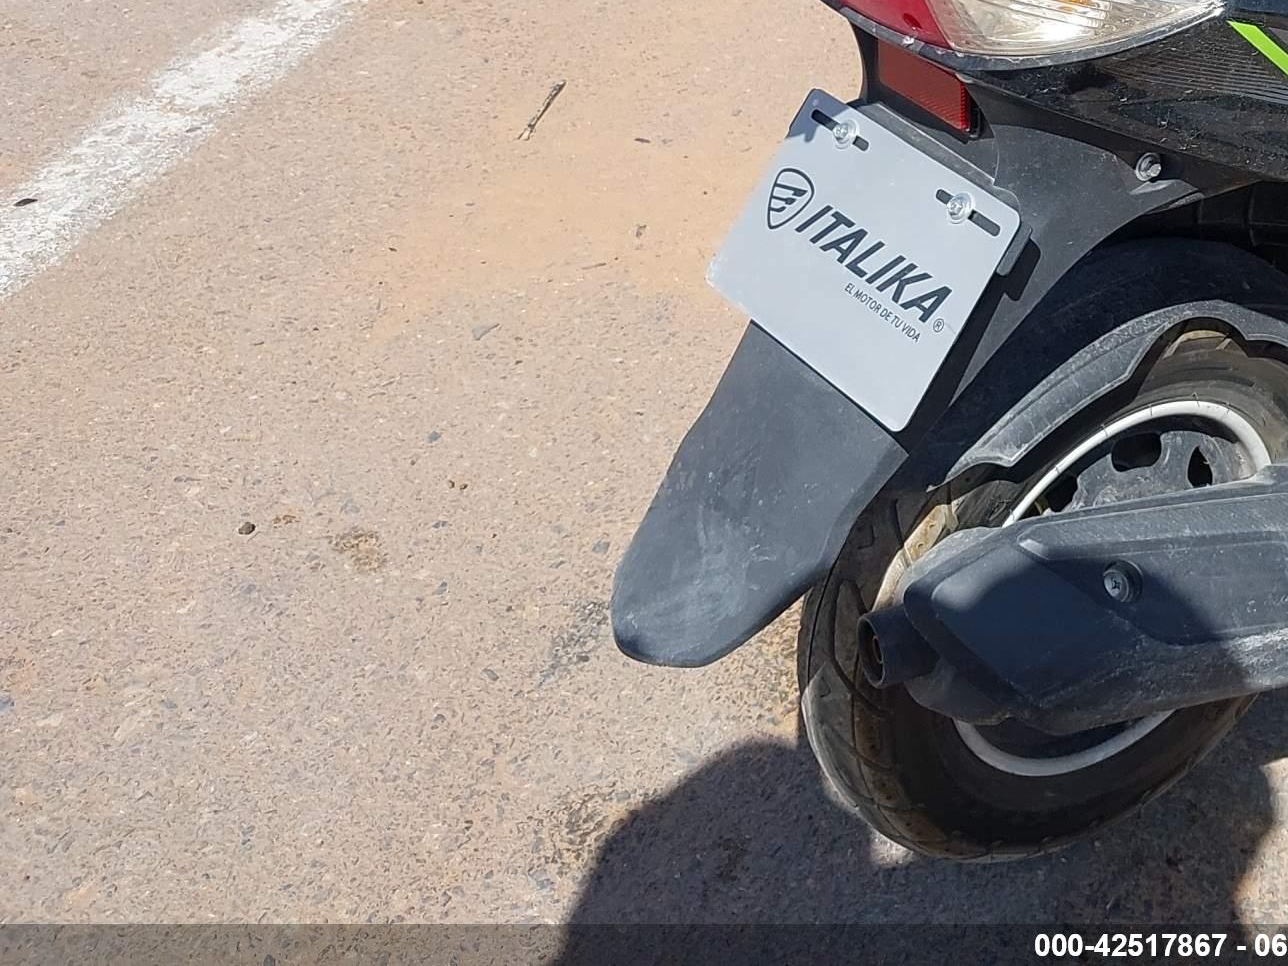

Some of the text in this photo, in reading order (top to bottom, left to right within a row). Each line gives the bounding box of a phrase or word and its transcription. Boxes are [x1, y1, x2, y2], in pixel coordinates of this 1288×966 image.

[794, 204, 953, 324] ITALIKA
[843, 282, 921, 343] EL MOTOR DE TU VIDA
